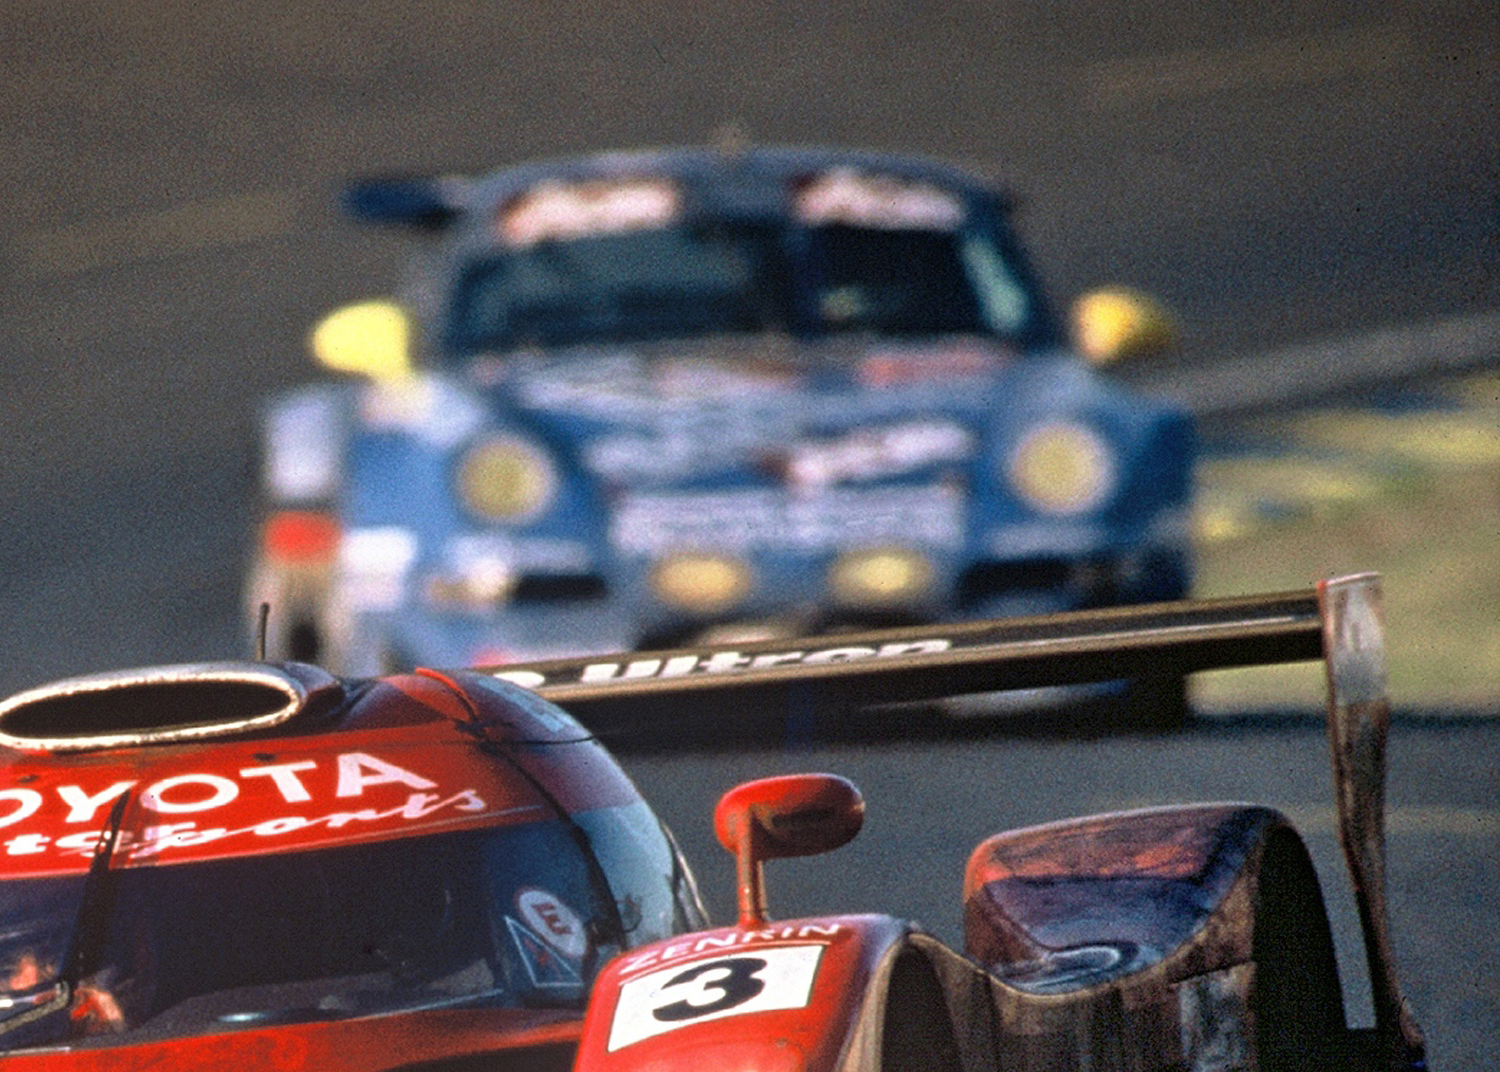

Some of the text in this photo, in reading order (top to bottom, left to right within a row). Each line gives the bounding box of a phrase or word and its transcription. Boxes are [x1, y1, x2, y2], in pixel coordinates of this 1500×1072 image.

[582, 640, 950, 684] Ultron
[619, 924, 840, 975] ZENRIN
[653, 957, 767, 1022] 3
